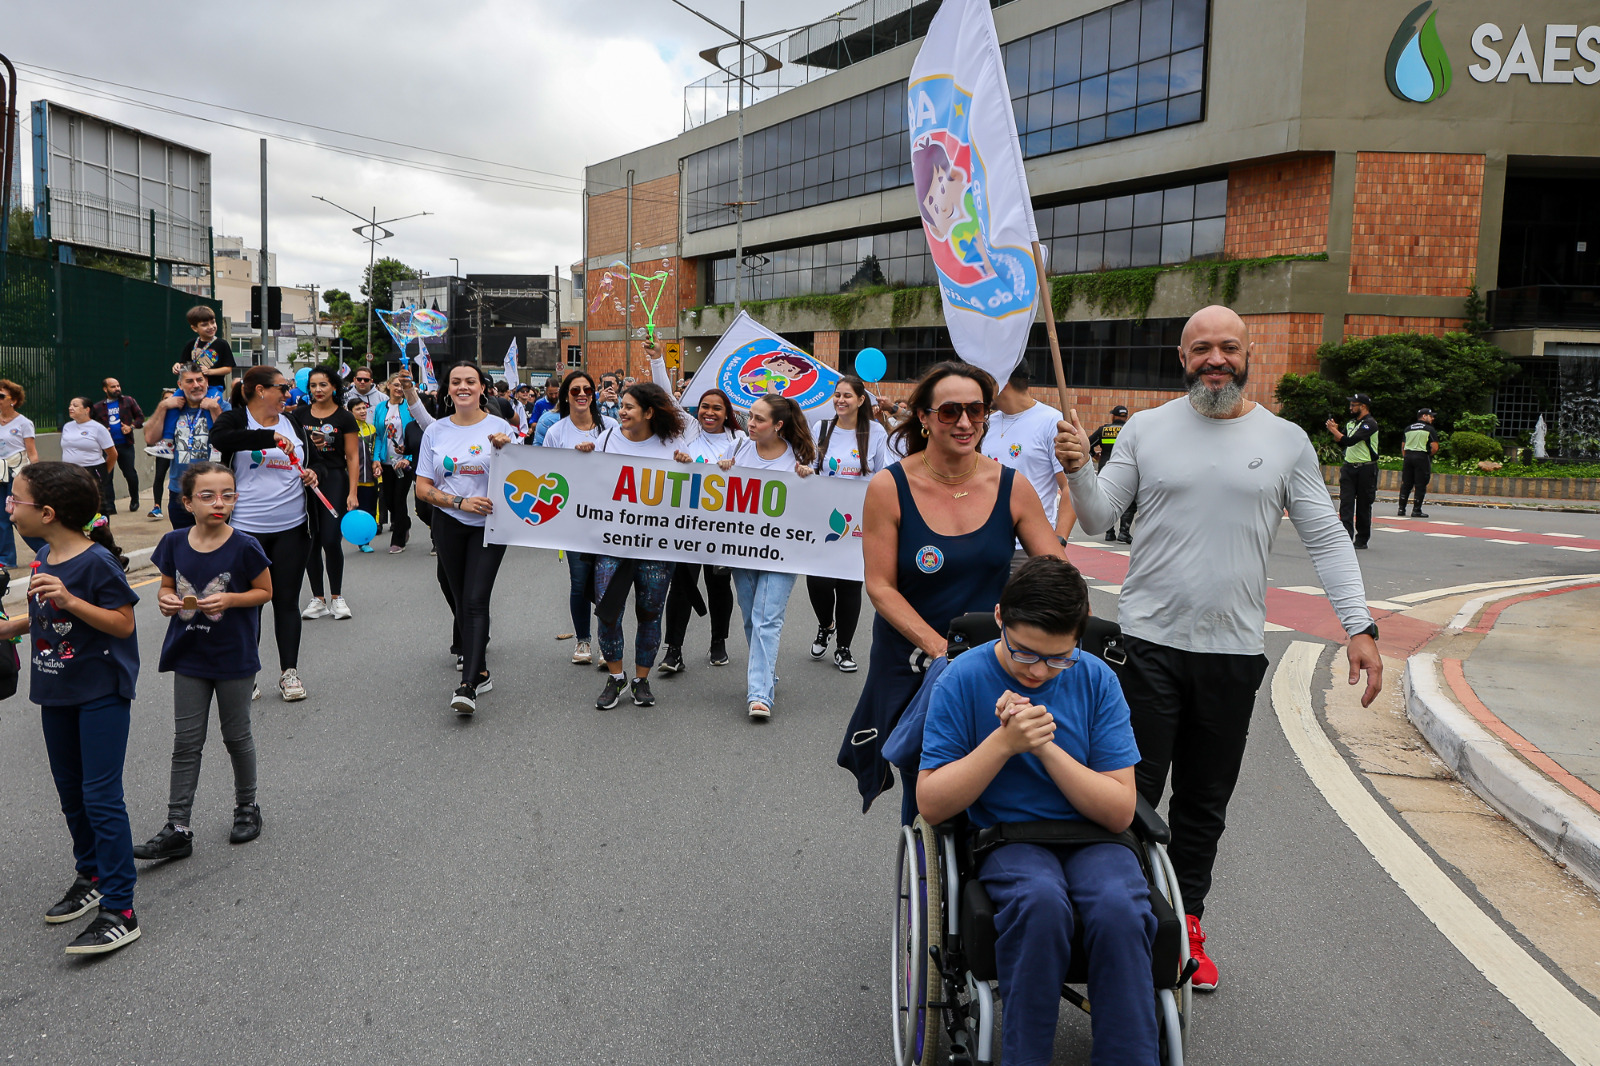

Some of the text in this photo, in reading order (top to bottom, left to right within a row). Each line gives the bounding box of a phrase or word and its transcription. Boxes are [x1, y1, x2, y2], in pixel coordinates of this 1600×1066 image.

[799, 391, 824, 407] utismo
[612, 465, 788, 517] AUTISMO
[576, 503, 817, 545] Uma forma diferente de ser,
[603, 532, 785, 562] sentir e ver o mundo.
